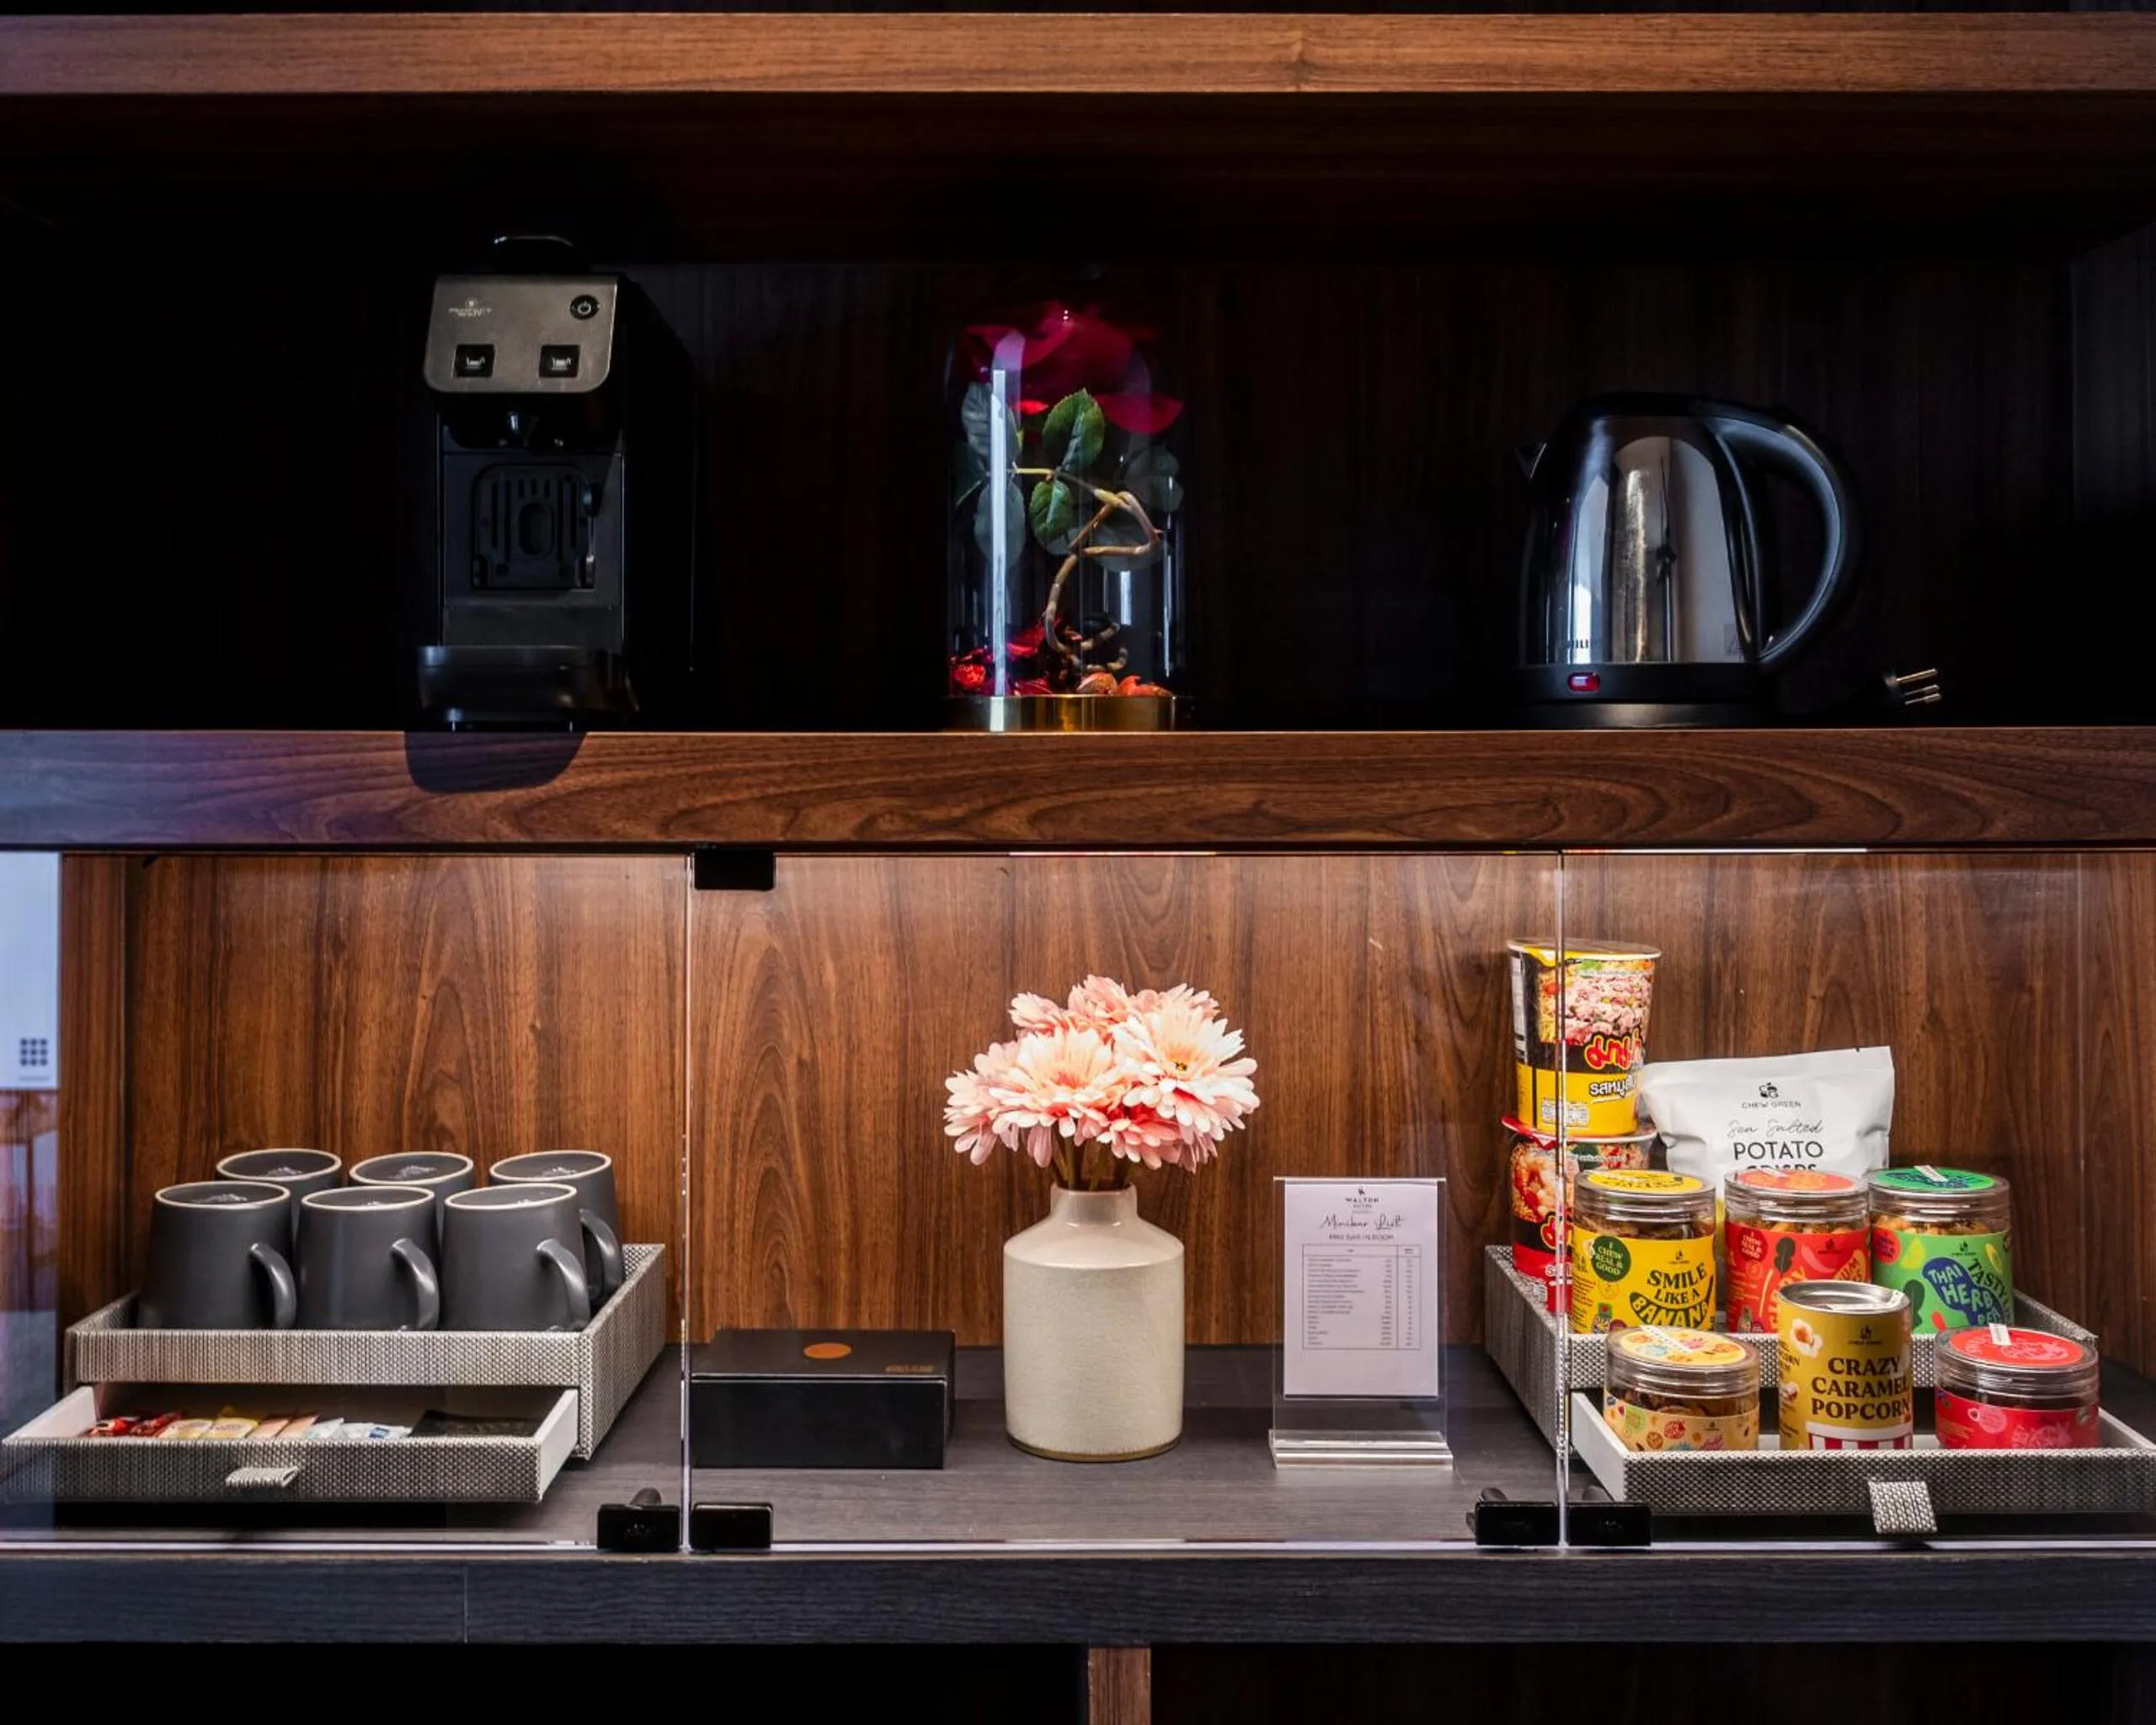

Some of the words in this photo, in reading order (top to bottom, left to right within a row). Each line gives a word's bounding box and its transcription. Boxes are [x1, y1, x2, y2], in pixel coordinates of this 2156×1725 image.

[1742, 1101, 1768, 1109] CHEW
[1770, 1100, 1801, 1108] GREEN
[1765, 1118, 1823, 1137] Salted
[1733, 1140, 1823, 1161] POTATO
[1318, 1213, 1369, 1230] Minibar
[1374, 1213, 1406, 1231] List
[1596, 1261, 1620, 1275] GOOD
[1646, 1262, 1707, 1290] SMILE
[1928, 1264, 1963, 1284] THAI
[1654, 1289, 1689, 1305] LIKE
[1692, 1288, 1700, 1300] A
[1941, 1284, 1993, 1311] HERB
[1828, 1356, 1900, 1376] CRAZY
[1812, 1375, 1909, 1398] CARAMEL
[1812, 1397, 1911, 1420] POPCORN
